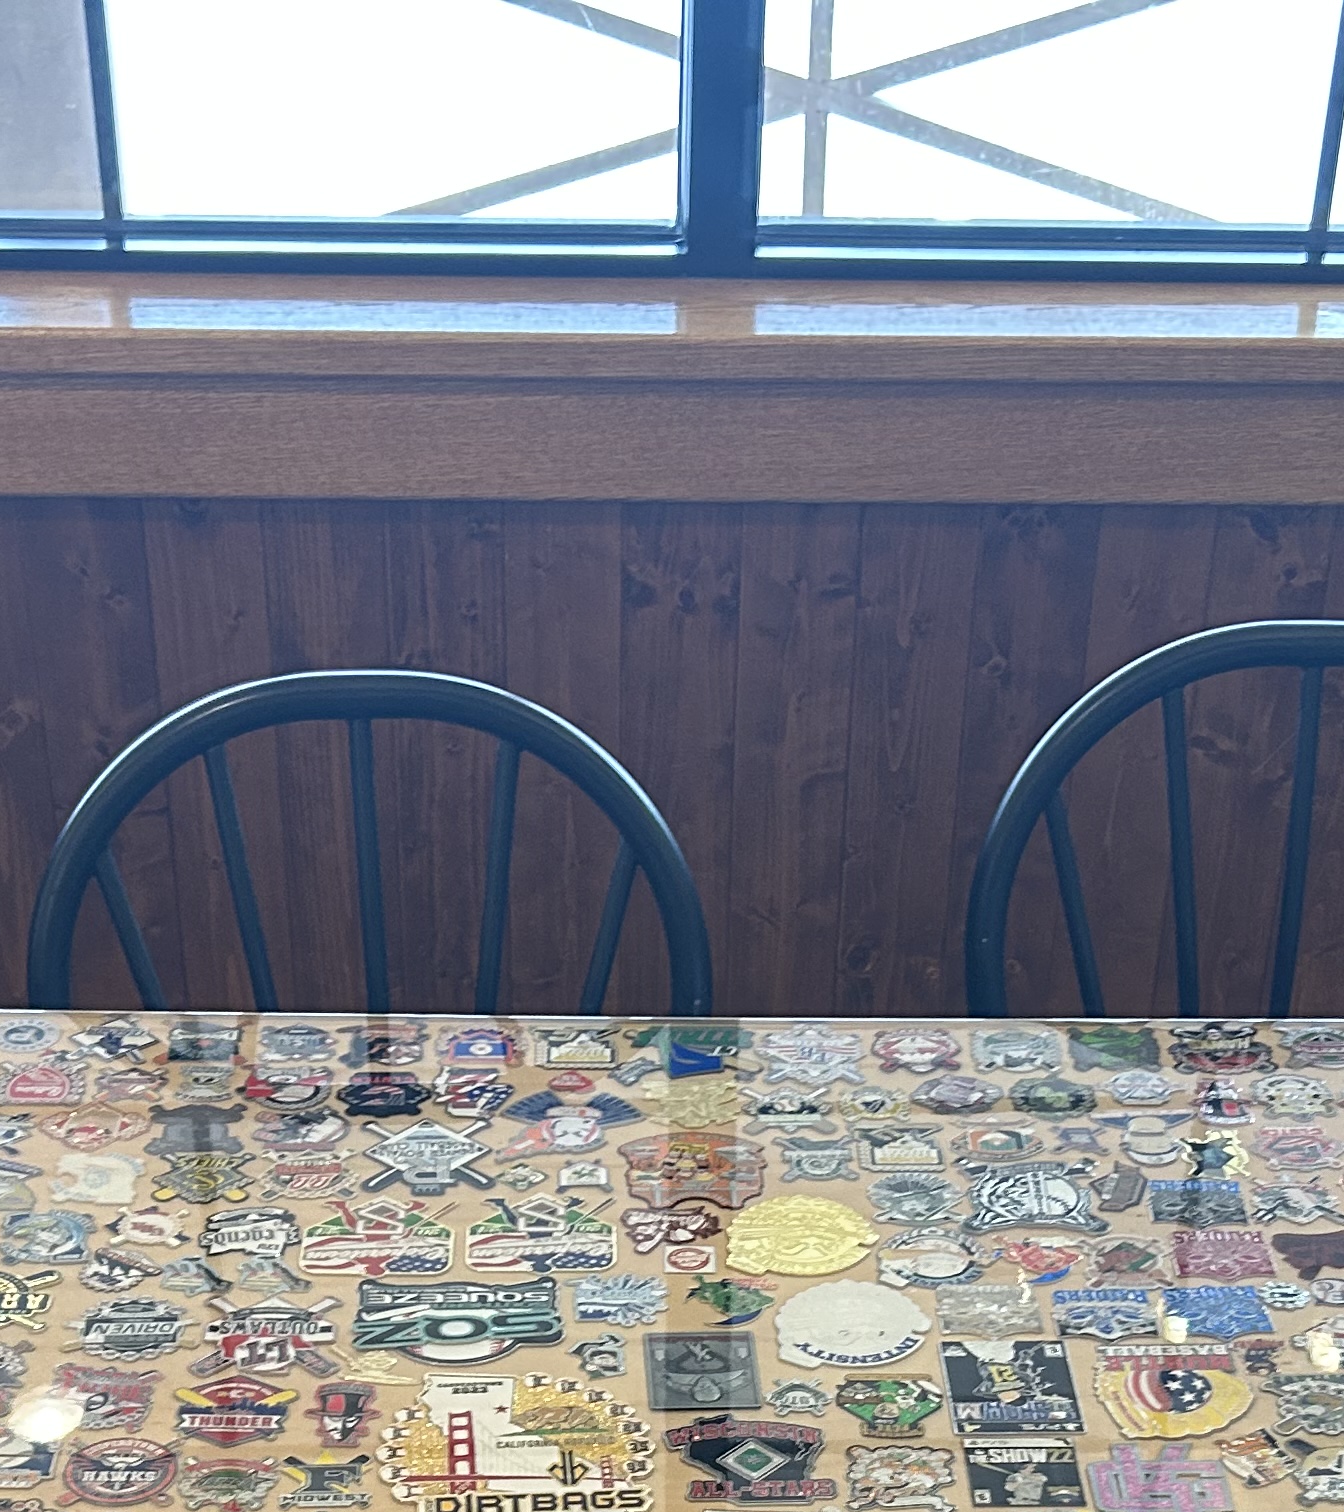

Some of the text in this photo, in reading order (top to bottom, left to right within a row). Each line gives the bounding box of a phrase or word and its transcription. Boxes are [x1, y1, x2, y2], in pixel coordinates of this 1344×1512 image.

[366, 1290, 549, 1305] SQUEEZE
[90, 1322, 173, 1336] DRIVEN
[220, 1320, 319, 1335] OUTLAWS
[353, 1309, 562, 1347] SQZ
[796, 1337, 917, 1363] INTENSITY
[1098, 1345, 1226, 1356] BASEBALL
[189, 1416, 275, 1428] THUNDER
[669, 1426, 821, 1446] WISCONSIN
[82, 1470, 156, 1484] HAWKS
[692, 1480, 834, 1498] ALL-STARS
[282, 1494, 367, 1507] MIDWEST
